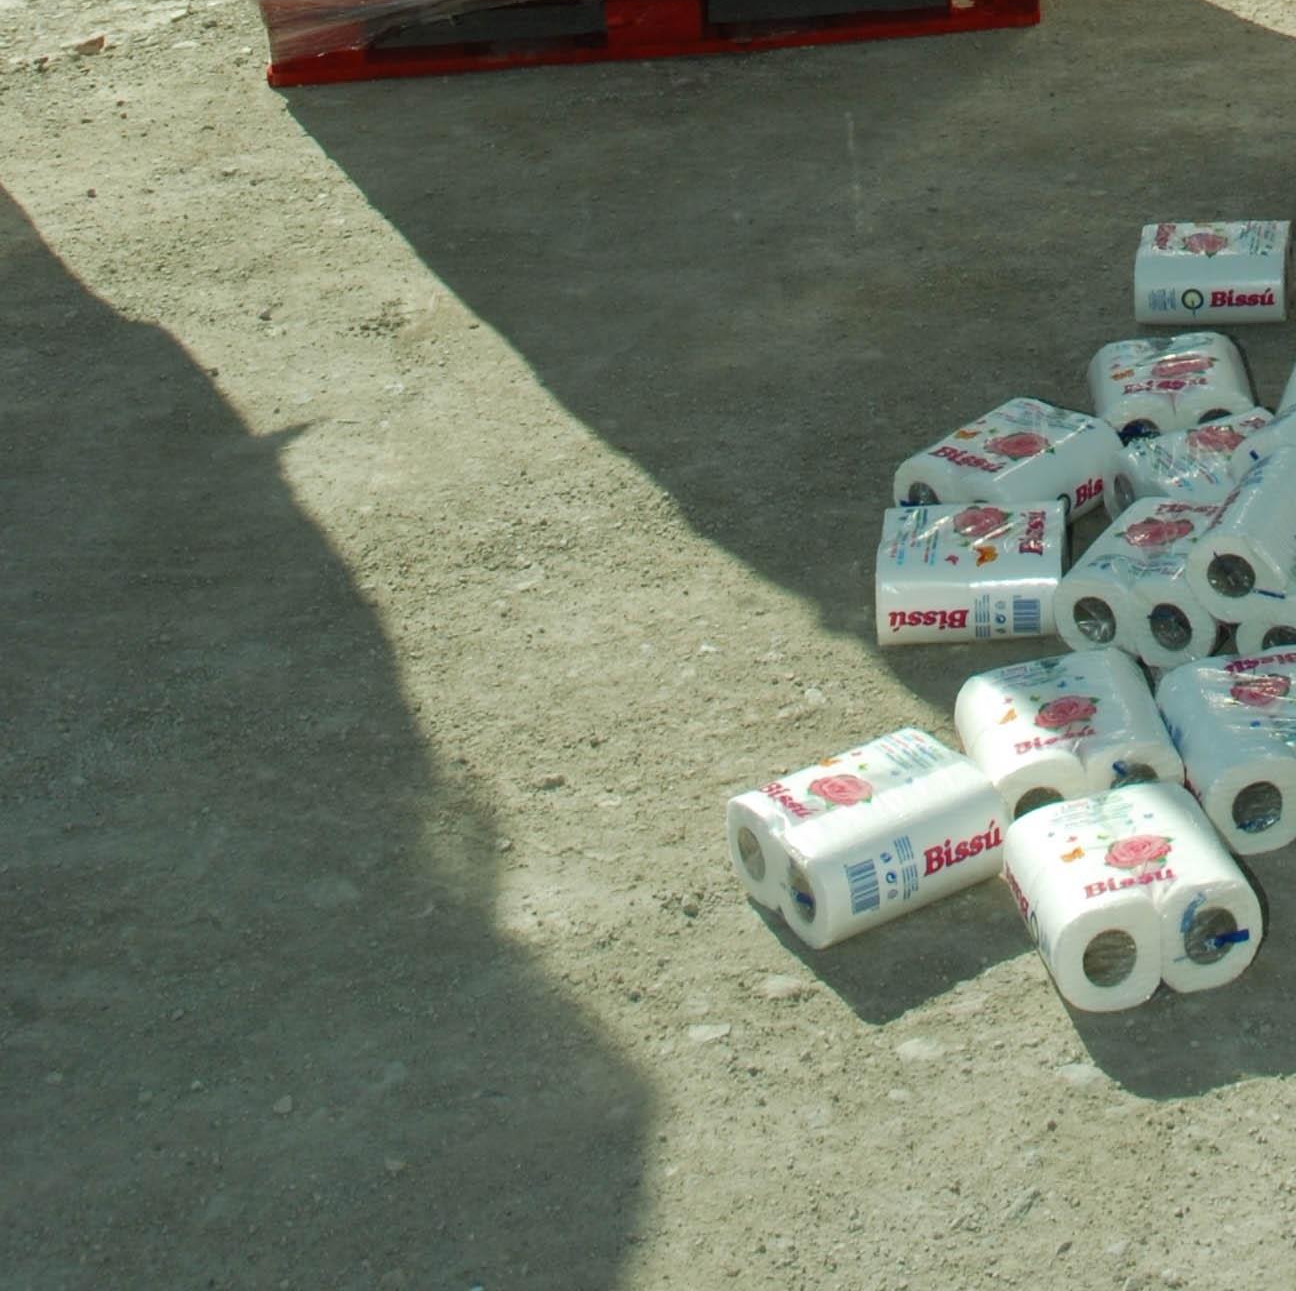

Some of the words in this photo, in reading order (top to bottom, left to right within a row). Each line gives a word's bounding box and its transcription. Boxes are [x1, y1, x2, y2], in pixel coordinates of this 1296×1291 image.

[1211, 290, 1275, 307] Bissú
[1076, 478, 1104, 506] Bis
[889, 609, 967, 628] Bissú
[925, 820, 1002, 876] Bissú
